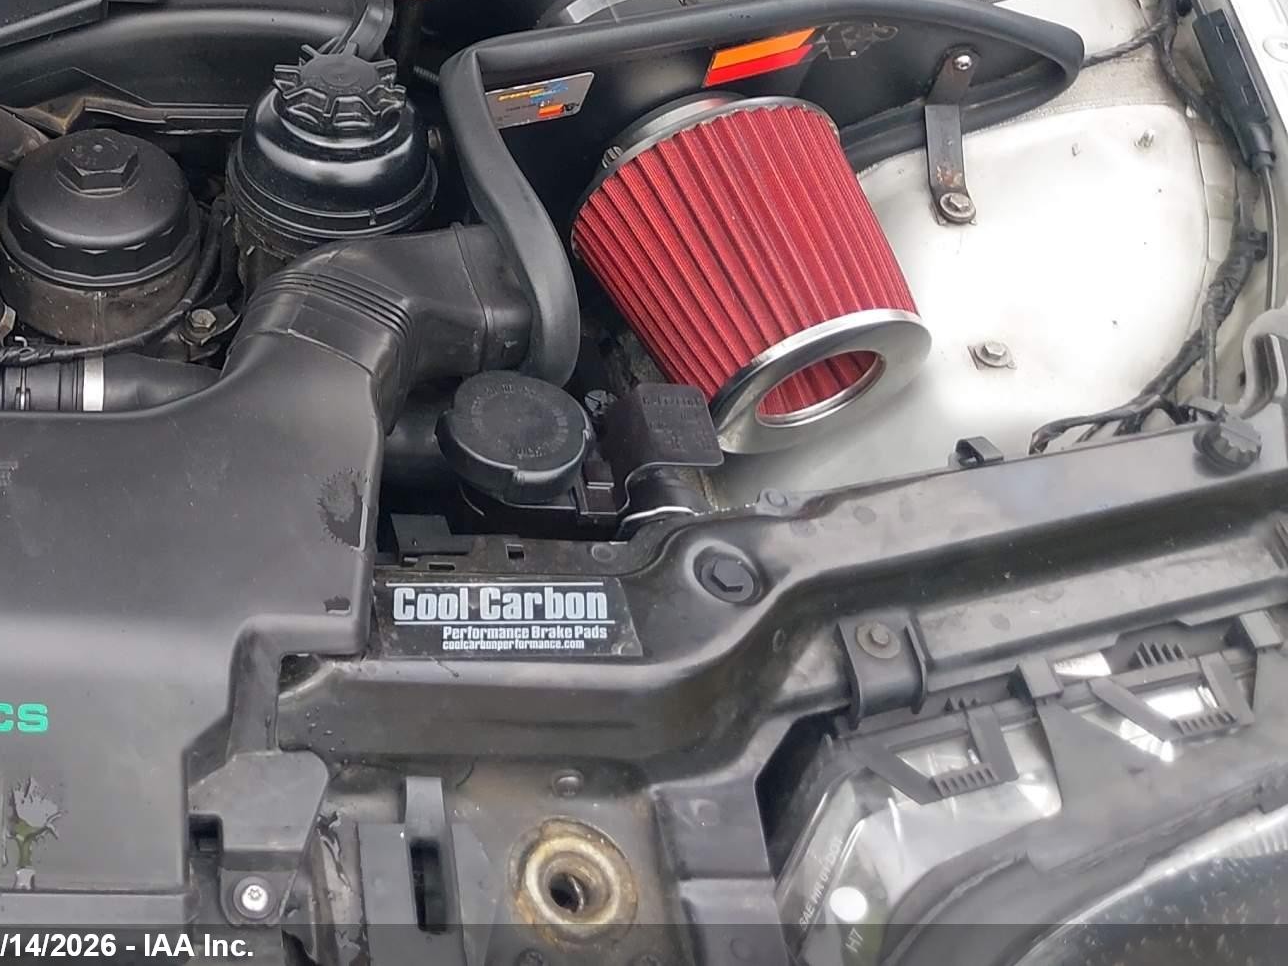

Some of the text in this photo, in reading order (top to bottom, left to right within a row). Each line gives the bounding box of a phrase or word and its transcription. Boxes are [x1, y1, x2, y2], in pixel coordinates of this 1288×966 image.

[393, 586, 608, 621] Cool Carbon
[443, 624, 608, 640] Performance Brake Pads
[442, 638, 585, 651] coolcarbonperformance.com
[845, 927, 864, 953] H7
